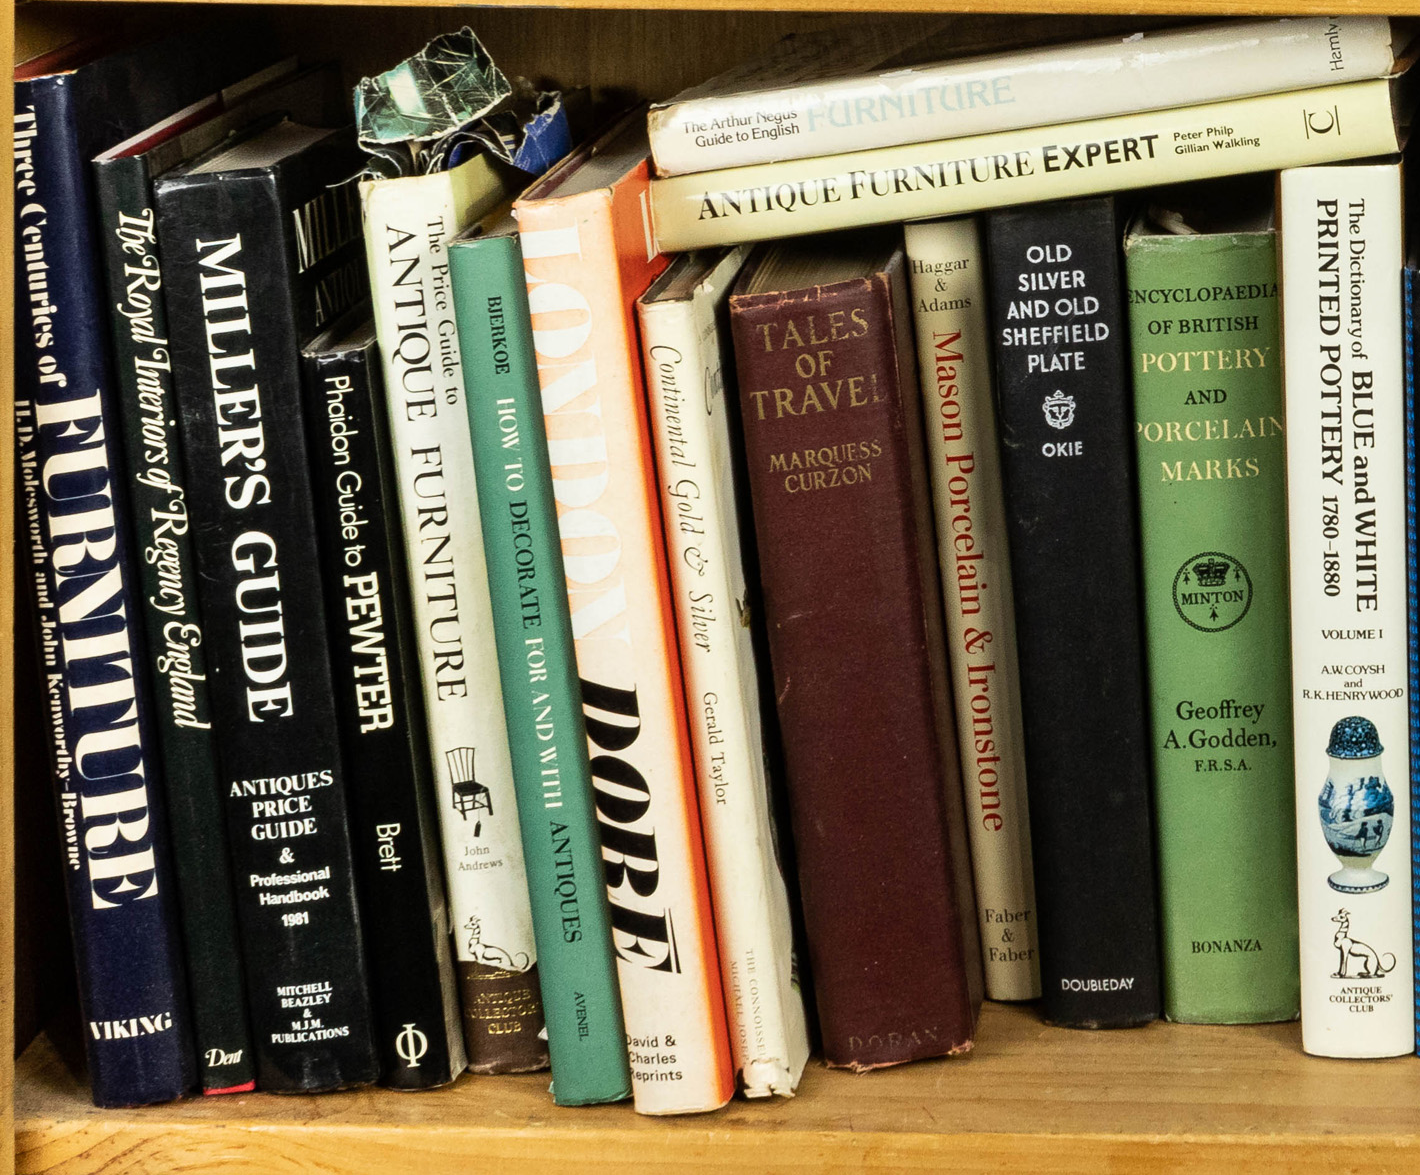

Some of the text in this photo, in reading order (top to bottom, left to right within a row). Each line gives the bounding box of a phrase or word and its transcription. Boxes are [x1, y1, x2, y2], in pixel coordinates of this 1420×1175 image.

[683, 110, 797, 134] The Arthur Negus
[695, 124, 800, 148] Guide to English
[1173, 124, 1234, 142] Peter Philp
[1174, 134, 1260, 155] Gillian Walkling
[698, 133, 1158, 221] ANTIQUE FURNITURE EXPERT
[1026, 245, 1072, 263] OLD
[912, 257, 969, 275] Haggar
[1317, 199, 1341, 336] PRINTED
[934, 278, 948, 292] &
[1018, 271, 1085, 290] SILVER
[918, 296, 971, 313] Adams
[1007, 298, 1099, 319] AND OLD
[1002, 323, 1109, 346] SHEFFIELD
[1148, 316, 1258, 335] OF BRITISH
[1027, 352, 1085, 373] PLATE
[1141, 347, 1270, 373] POTTERY
[1320, 344, 1344, 486] POTTERY
[1042, 442, 1083, 457] OKIE
[1182, 591, 1244, 605] MINTON
[230, 530, 294, 724] GUIDE
[1175, 702, 1265, 722] Geoffrey
[1195, 759, 1252, 772] F.R.S.A.
[230, 770, 333, 797] ANTIQUES
[252, 796, 312, 819] PRICE
[251, 819, 317, 840] GUIDE
[376, 823, 401, 872] Brett
[250, 867, 331, 887] Professional
[260, 886, 330, 905] Handbook
[282, 912, 309, 927] 1981
[1191, 940, 1262, 954] BONANZA
[1061, 978, 1134, 991] DOUBLEDAY
[89, 1012, 173, 1041] VIKING
[573, 991, 589, 1042] AVENEL
[205, 1048, 243, 1068] Dent
